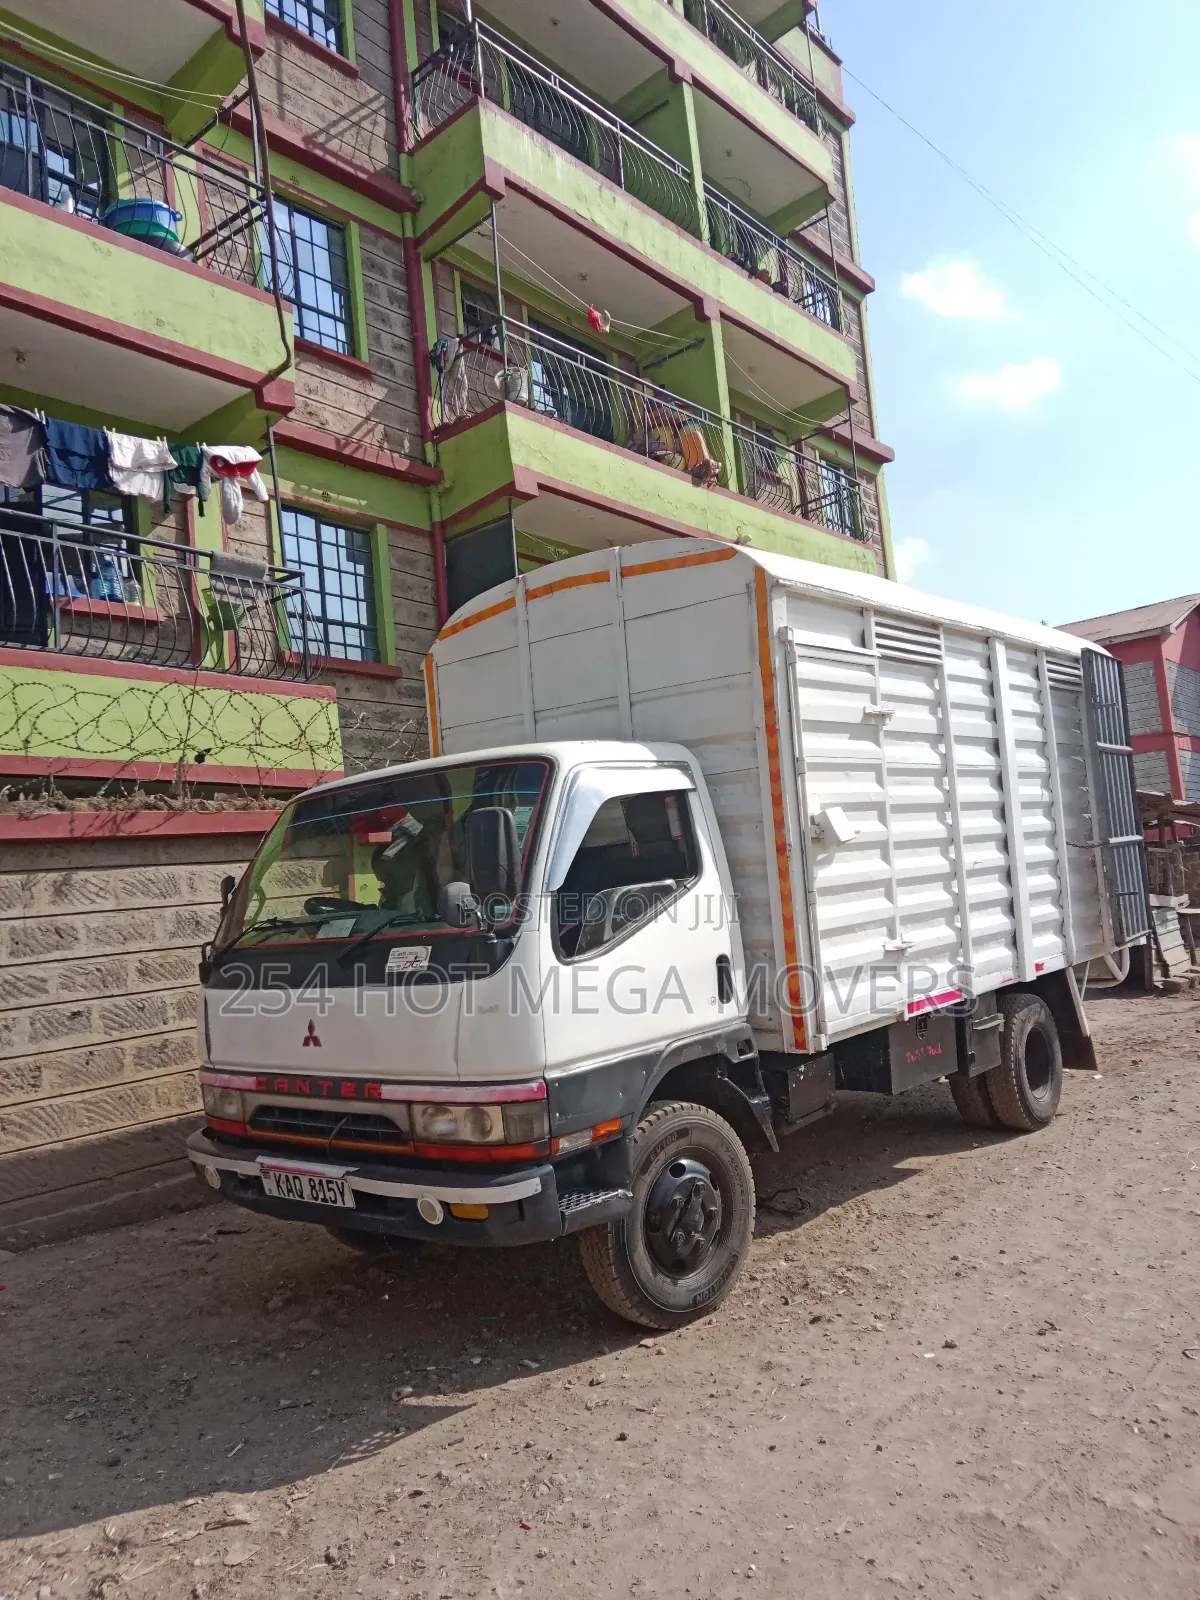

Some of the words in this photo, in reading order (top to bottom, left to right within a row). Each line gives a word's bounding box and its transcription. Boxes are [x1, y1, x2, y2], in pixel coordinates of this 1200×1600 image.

[255, 1076, 382, 1099] CANTER
[273, 1172, 305, 1200] KAQ
[308, 1177, 346, 1206] 815Y
